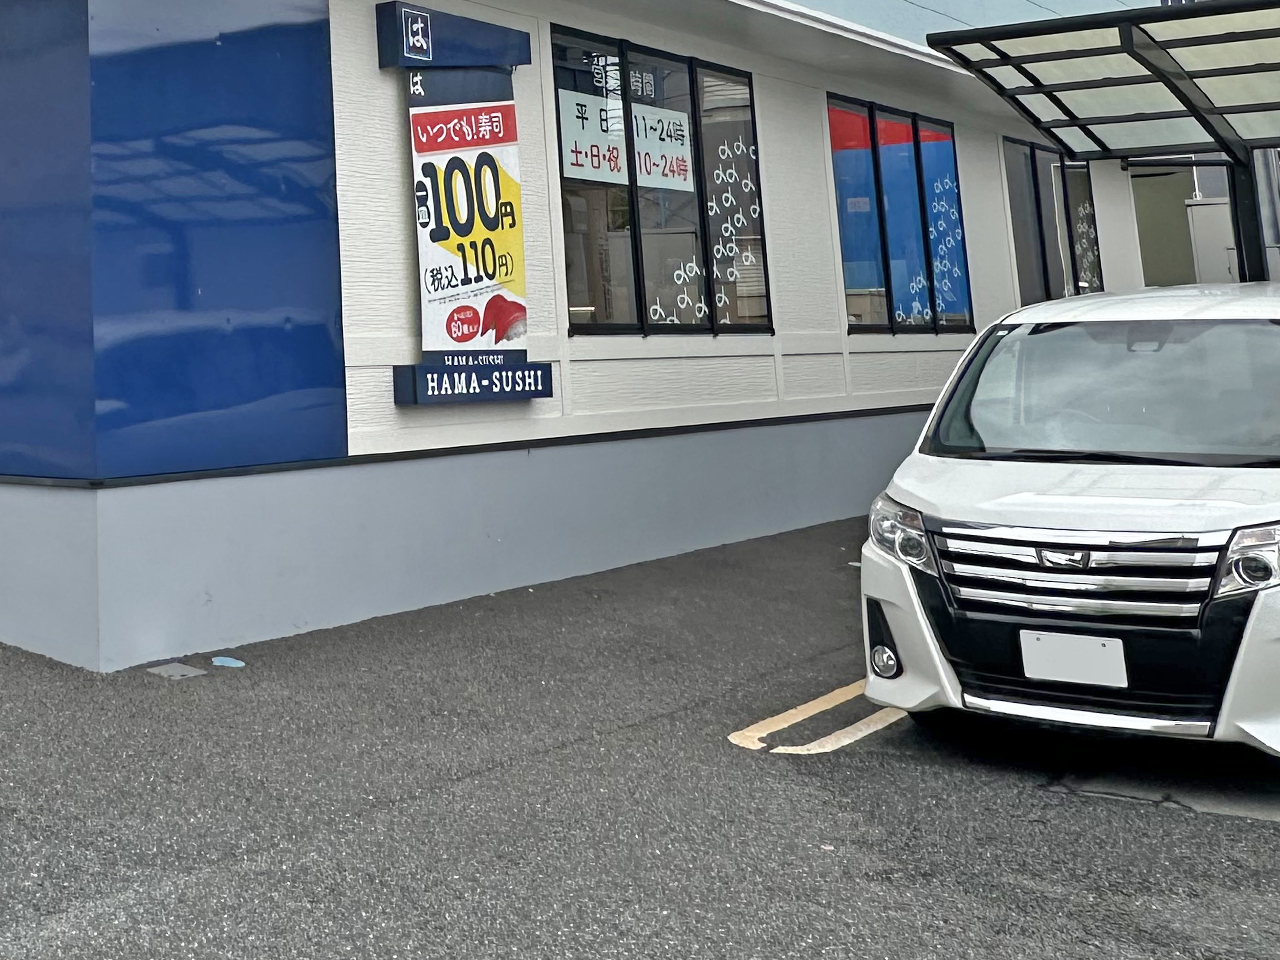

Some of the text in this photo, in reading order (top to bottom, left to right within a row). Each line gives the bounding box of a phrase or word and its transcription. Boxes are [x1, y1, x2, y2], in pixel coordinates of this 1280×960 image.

[408, 17, 427, 50] は
[410, 72, 424, 96] は
[421, 152, 516, 243] 100円
[426, 370, 542, 395] HAMA-SUSHI
